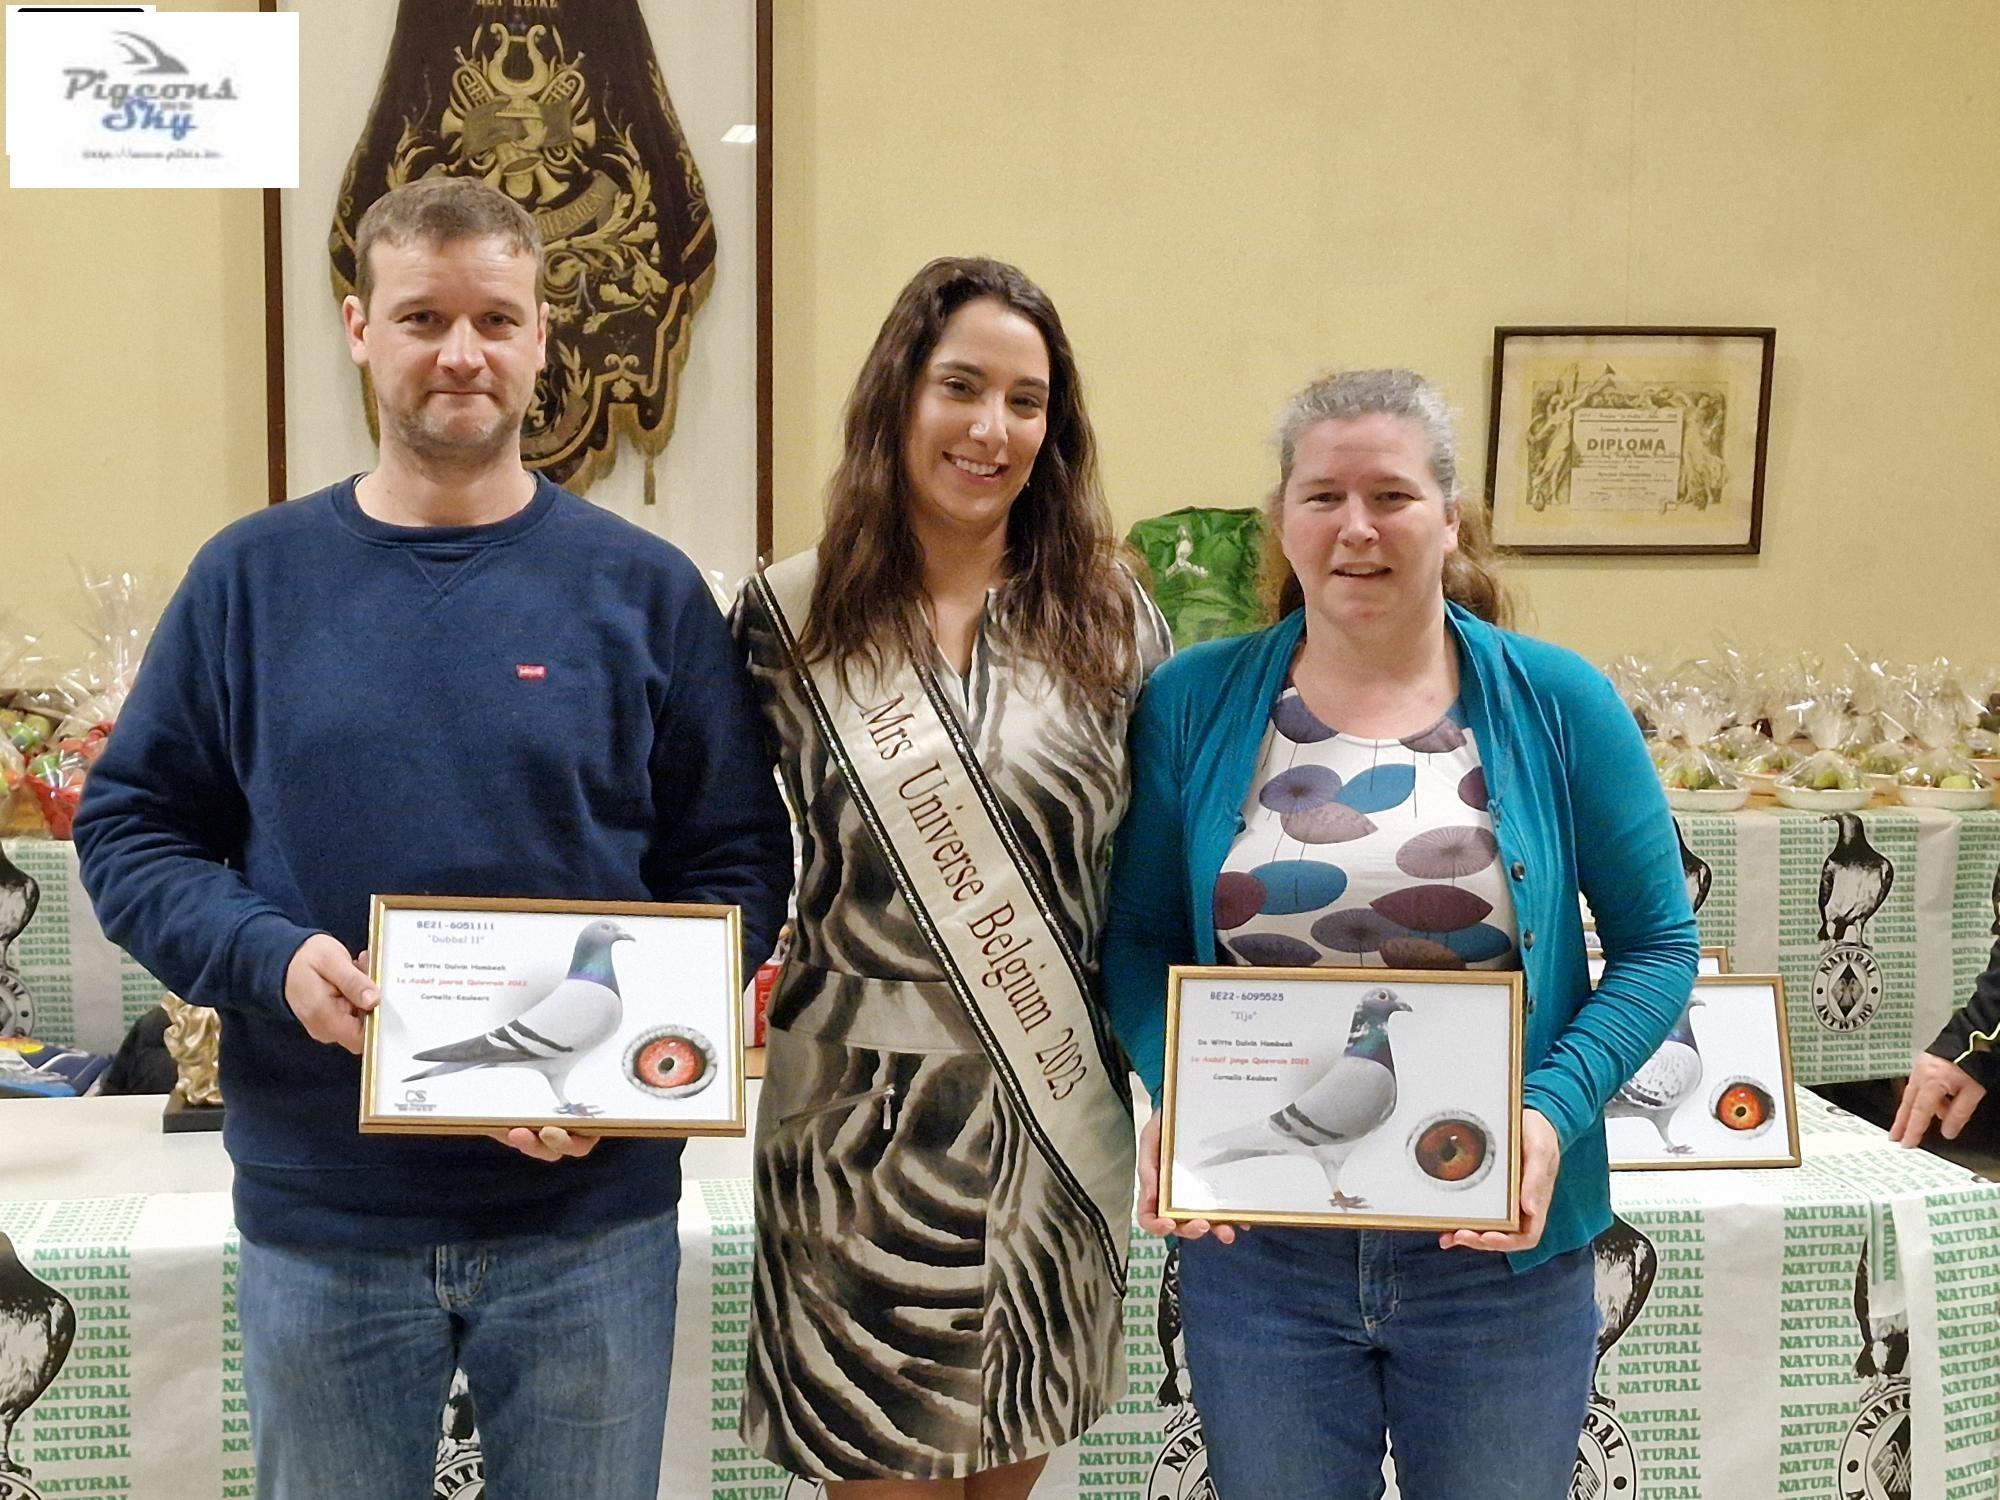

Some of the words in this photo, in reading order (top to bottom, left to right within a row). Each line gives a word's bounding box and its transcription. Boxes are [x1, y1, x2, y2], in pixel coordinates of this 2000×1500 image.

[1587, 438, 1666, 451] DIPLOMA
[859, 692, 915, 761] Mrs
[899, 760, 985, 902] Universe
[966, 899, 1052, 1034] Belgium
[1035, 1027, 1087, 1101] 2023
[1820, 951, 1876, 978] NATURAL
[1816, 1003, 1873, 1030] ANTWERP
[1784, 1205, 1867, 1220] NATURAL
[1928, 1207, 1998, 1227] NATURA
[1644, 1229, 1705, 1242] TURAL
[1784, 1224, 1867, 1240] NATURAL
[33, 1246, 131, 1260] NATURAL
[1933, 1244, 2000, 1265] NATURA
[1658, 1267, 1704, 1280] URAL
[1782, 1261, 1857, 1276] NATURA
[1934, 1263, 2000, 1284] NATURA
[60, 1286, 131, 1301] TURAL
[1654, 1285, 1703, 1298] URAL
[1781, 1279, 1853, 1294] NATURA
[1936, 1282, 2000, 1303] NATURA
[1642, 1304, 1702, 1318] TURAL
[1781, 1297, 1852, 1312] NATURA
[1625, 1323, 1702, 1337] ATURAL
[1780, 1315, 1858, 1331] NATURA
[74, 1345, 131, 1360] URAL
[1618, 1341, 1701, 1356] NATURAL
[1939, 1336, 2000, 1359] NATURA
[1618, 1359, 1701, 1375] NATURAL
[1780, 1353, 1857, 1368] NATURA
[1940, 1355, 2000, 1377] NATURA
[59, 1364, 131, 1380] TURAL
[42, 1384, 131, 1400] ATURAL
[1618, 1378, 1701, 1394] NATURAL
[1942, 1373, 2000, 1396] NATURA
[1944, 1392, 2000, 1415] NATURA
[33, 1404, 131, 1420] NATURAL
[33, 1423, 131, 1441] NATURAL
[1631, 1427, 1701, 1442] ATURAL
[1780, 1420, 1848, 1437] NATURA
[33, 1444, 131, 1462] NATURAL
[1079, 1451, 1153, 1466] NATURA
[1636, 1446, 1701, 1461] TURAL
[1640, 1466, 1701, 1480] TURAL
[1779, 1458, 1836, 1475] NATUR
[1778, 1476, 1836, 1493] NATUR
[1640, 1486, 1702, 1500] TURAL
